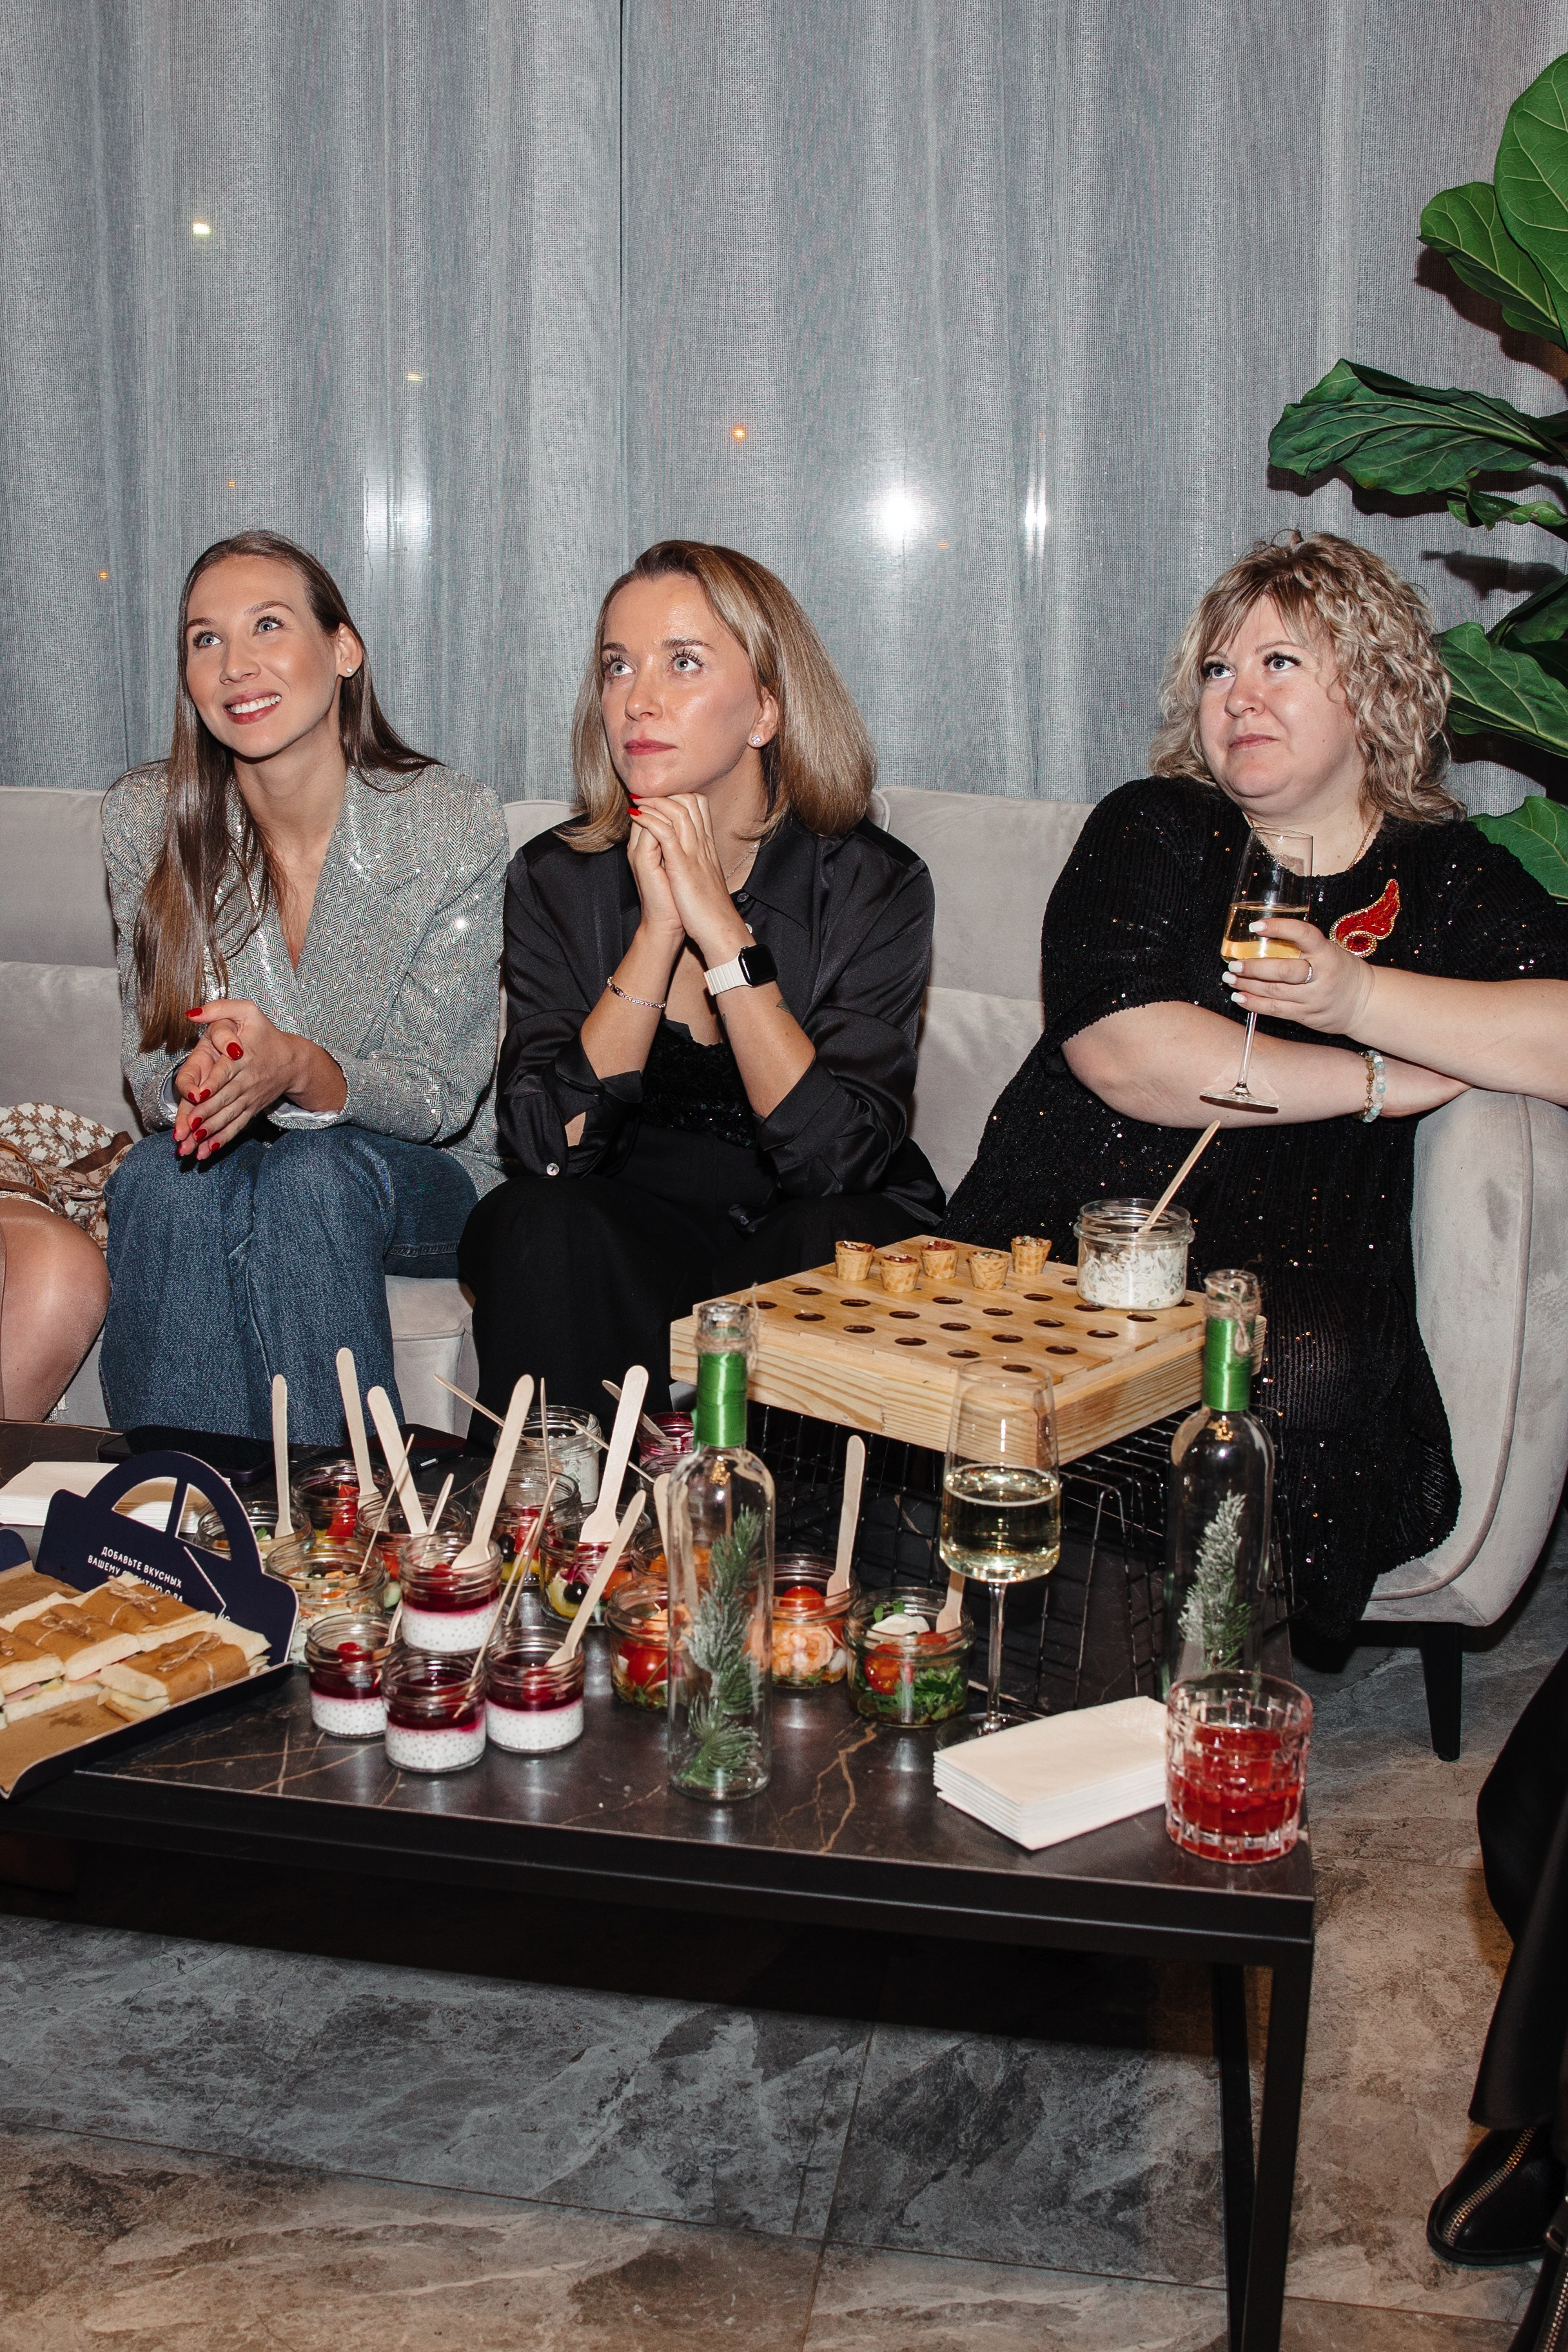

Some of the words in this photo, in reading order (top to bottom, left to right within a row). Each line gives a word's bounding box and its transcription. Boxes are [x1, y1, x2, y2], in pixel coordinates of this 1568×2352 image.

[87, 1554, 121, 1575] ВАШЕМУ
[101, 1546, 142, 1571] ДОБАВЬТЕ
[143, 1564, 182, 1589] ВКУСНЫХ
